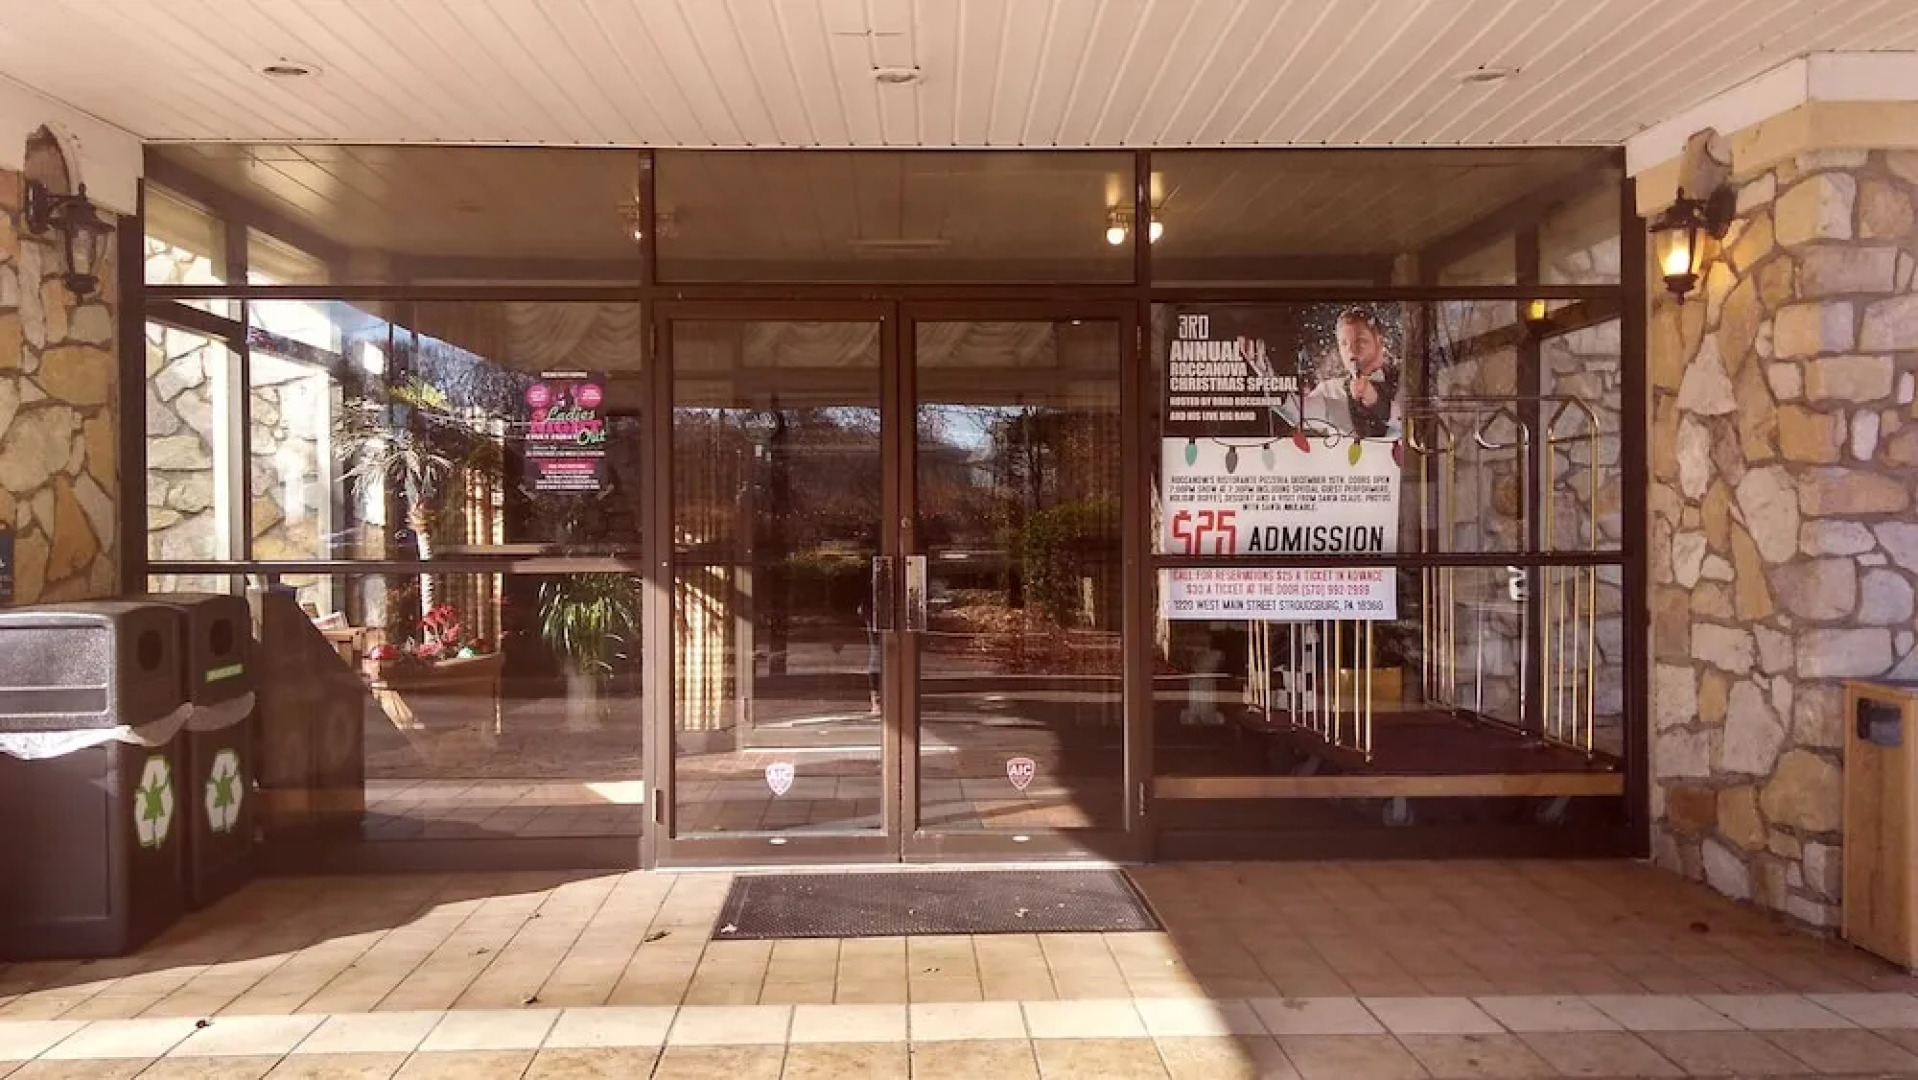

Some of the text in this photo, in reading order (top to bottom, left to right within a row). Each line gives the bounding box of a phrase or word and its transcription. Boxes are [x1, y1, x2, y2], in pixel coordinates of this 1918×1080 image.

[1178, 315, 1209, 339] 3RD
[1170, 340, 1244, 361] ANNUAL
[1170, 362, 1247, 376] ROCCANOVA
[1170, 377, 1299, 392] CHRISTMAS SPECIAL
[1290, 475, 1325, 484] DECEMBER
[1255, 485, 1290, 493] INCLUDING
[1293, 485, 1319, 493] SPECIAL
[1321, 485, 1343, 493] GUEST
[1173, 510, 1236, 555] $25
[1249, 526, 1384, 551] ADMISSION
[1173, 570, 1192, 581] CALL
[1196, 570, 1212, 581] FOR
[1215, 570, 1274, 581] RESERVATIONS
[1304, 570, 1332, 581] TICKET
[1347, 570, 1383, 581] ADVANCE
[1213, 583, 1244, 596] TICKET
[1258, 583, 1273, 596] THE
[1276, 583, 1299, 596] DOOR
[1196, 600, 1219, 611] WEST
[1221, 600, 1244, 611] MAIN
[1246, 600, 1277, 611] STREET
